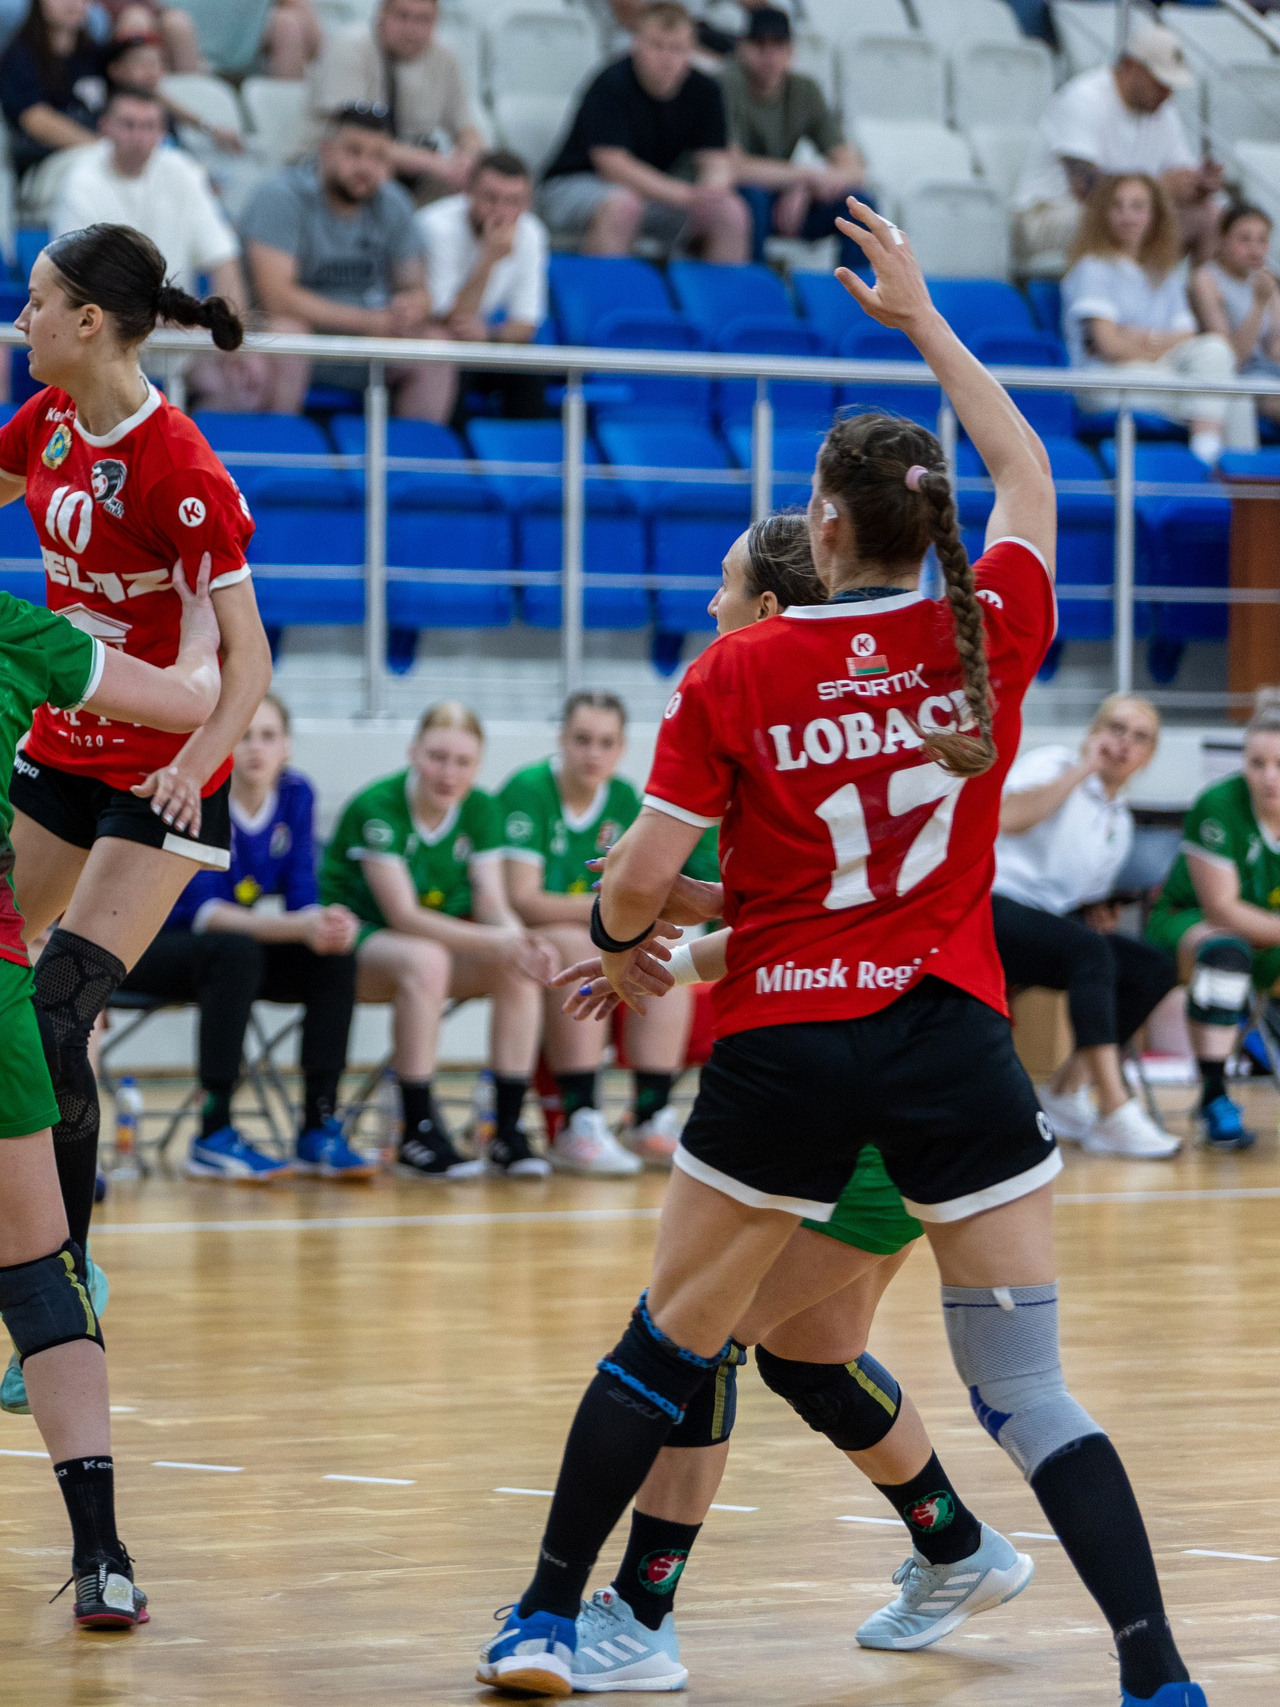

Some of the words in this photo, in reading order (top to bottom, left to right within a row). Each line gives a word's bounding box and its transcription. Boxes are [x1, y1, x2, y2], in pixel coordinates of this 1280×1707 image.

[45, 485, 93, 555] 10
[40, 545, 173, 604] ELAZ
[816, 663, 929, 700] SPORTIX
[815, 761, 967, 910] 17
[756, 958, 849, 994] Minsk
